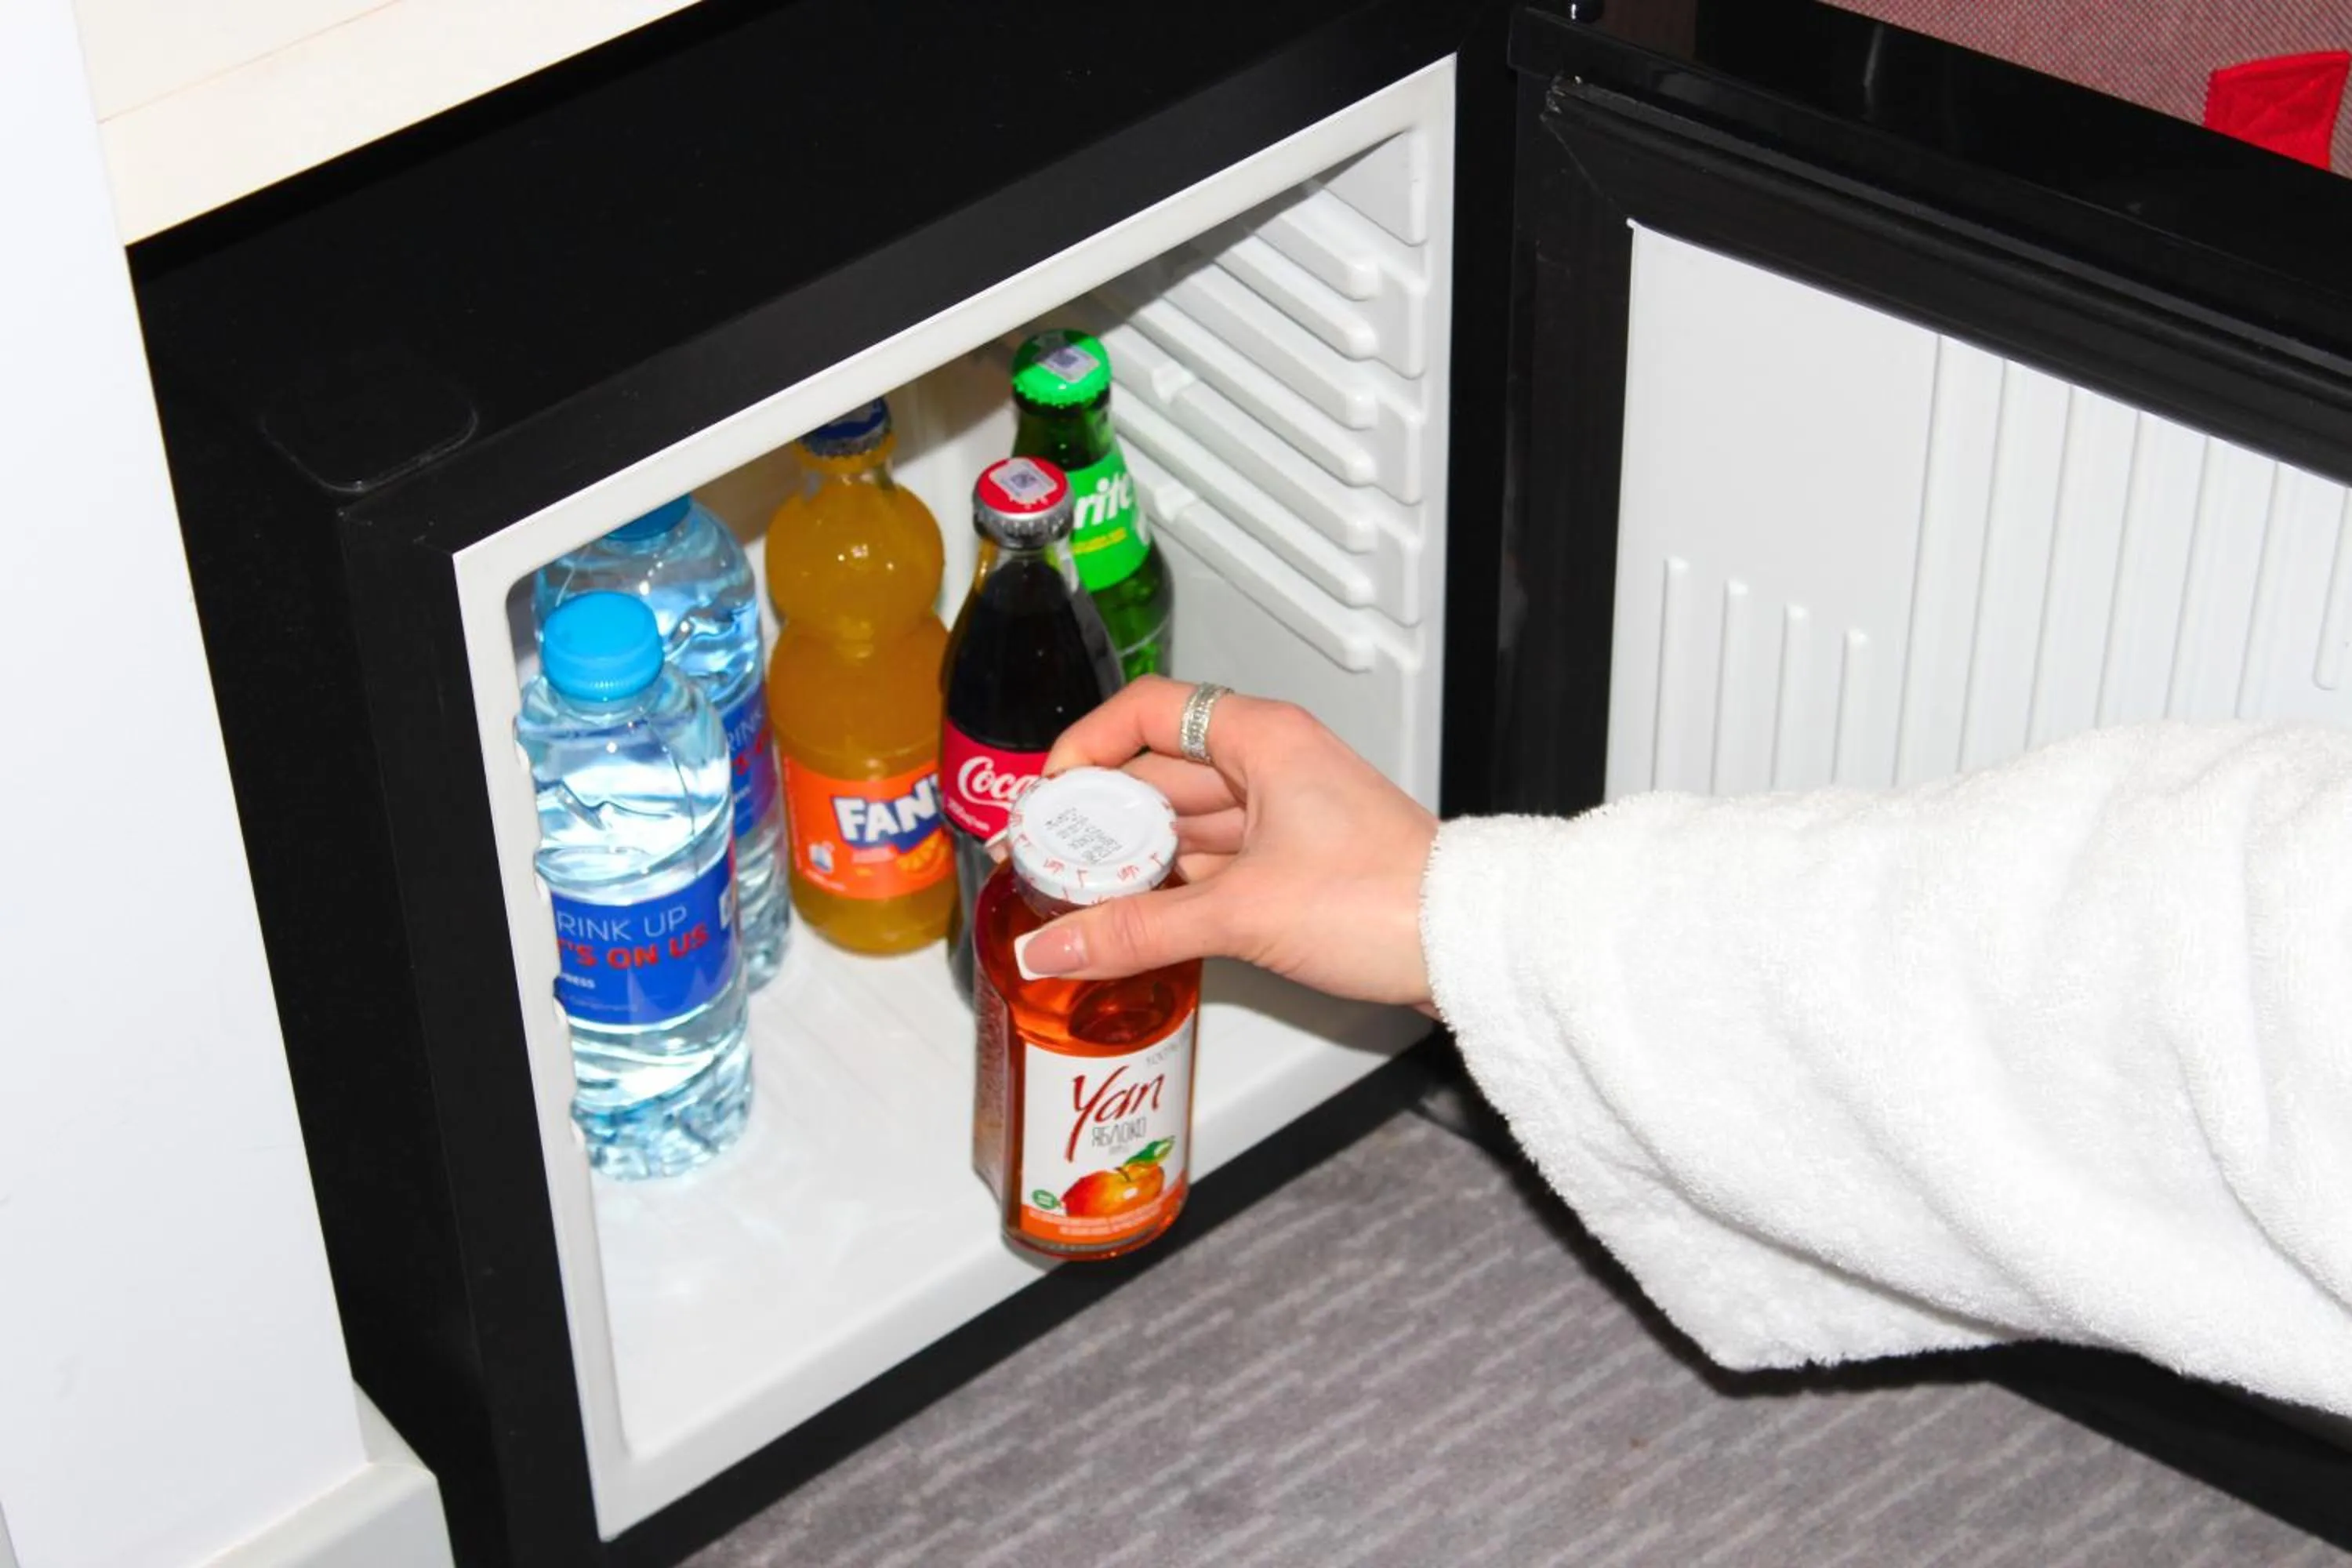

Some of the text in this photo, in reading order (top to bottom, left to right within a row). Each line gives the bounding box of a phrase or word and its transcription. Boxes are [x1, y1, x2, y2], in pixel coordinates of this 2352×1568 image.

[1073, 473, 1132, 530] rit
[833, 773, 938, 843] FAN
[556, 906, 688, 942] RINK UP
[607, 943, 659, 970] ON
[670, 922, 710, 958] US
[1065, 1065, 1166, 1163] Yan
